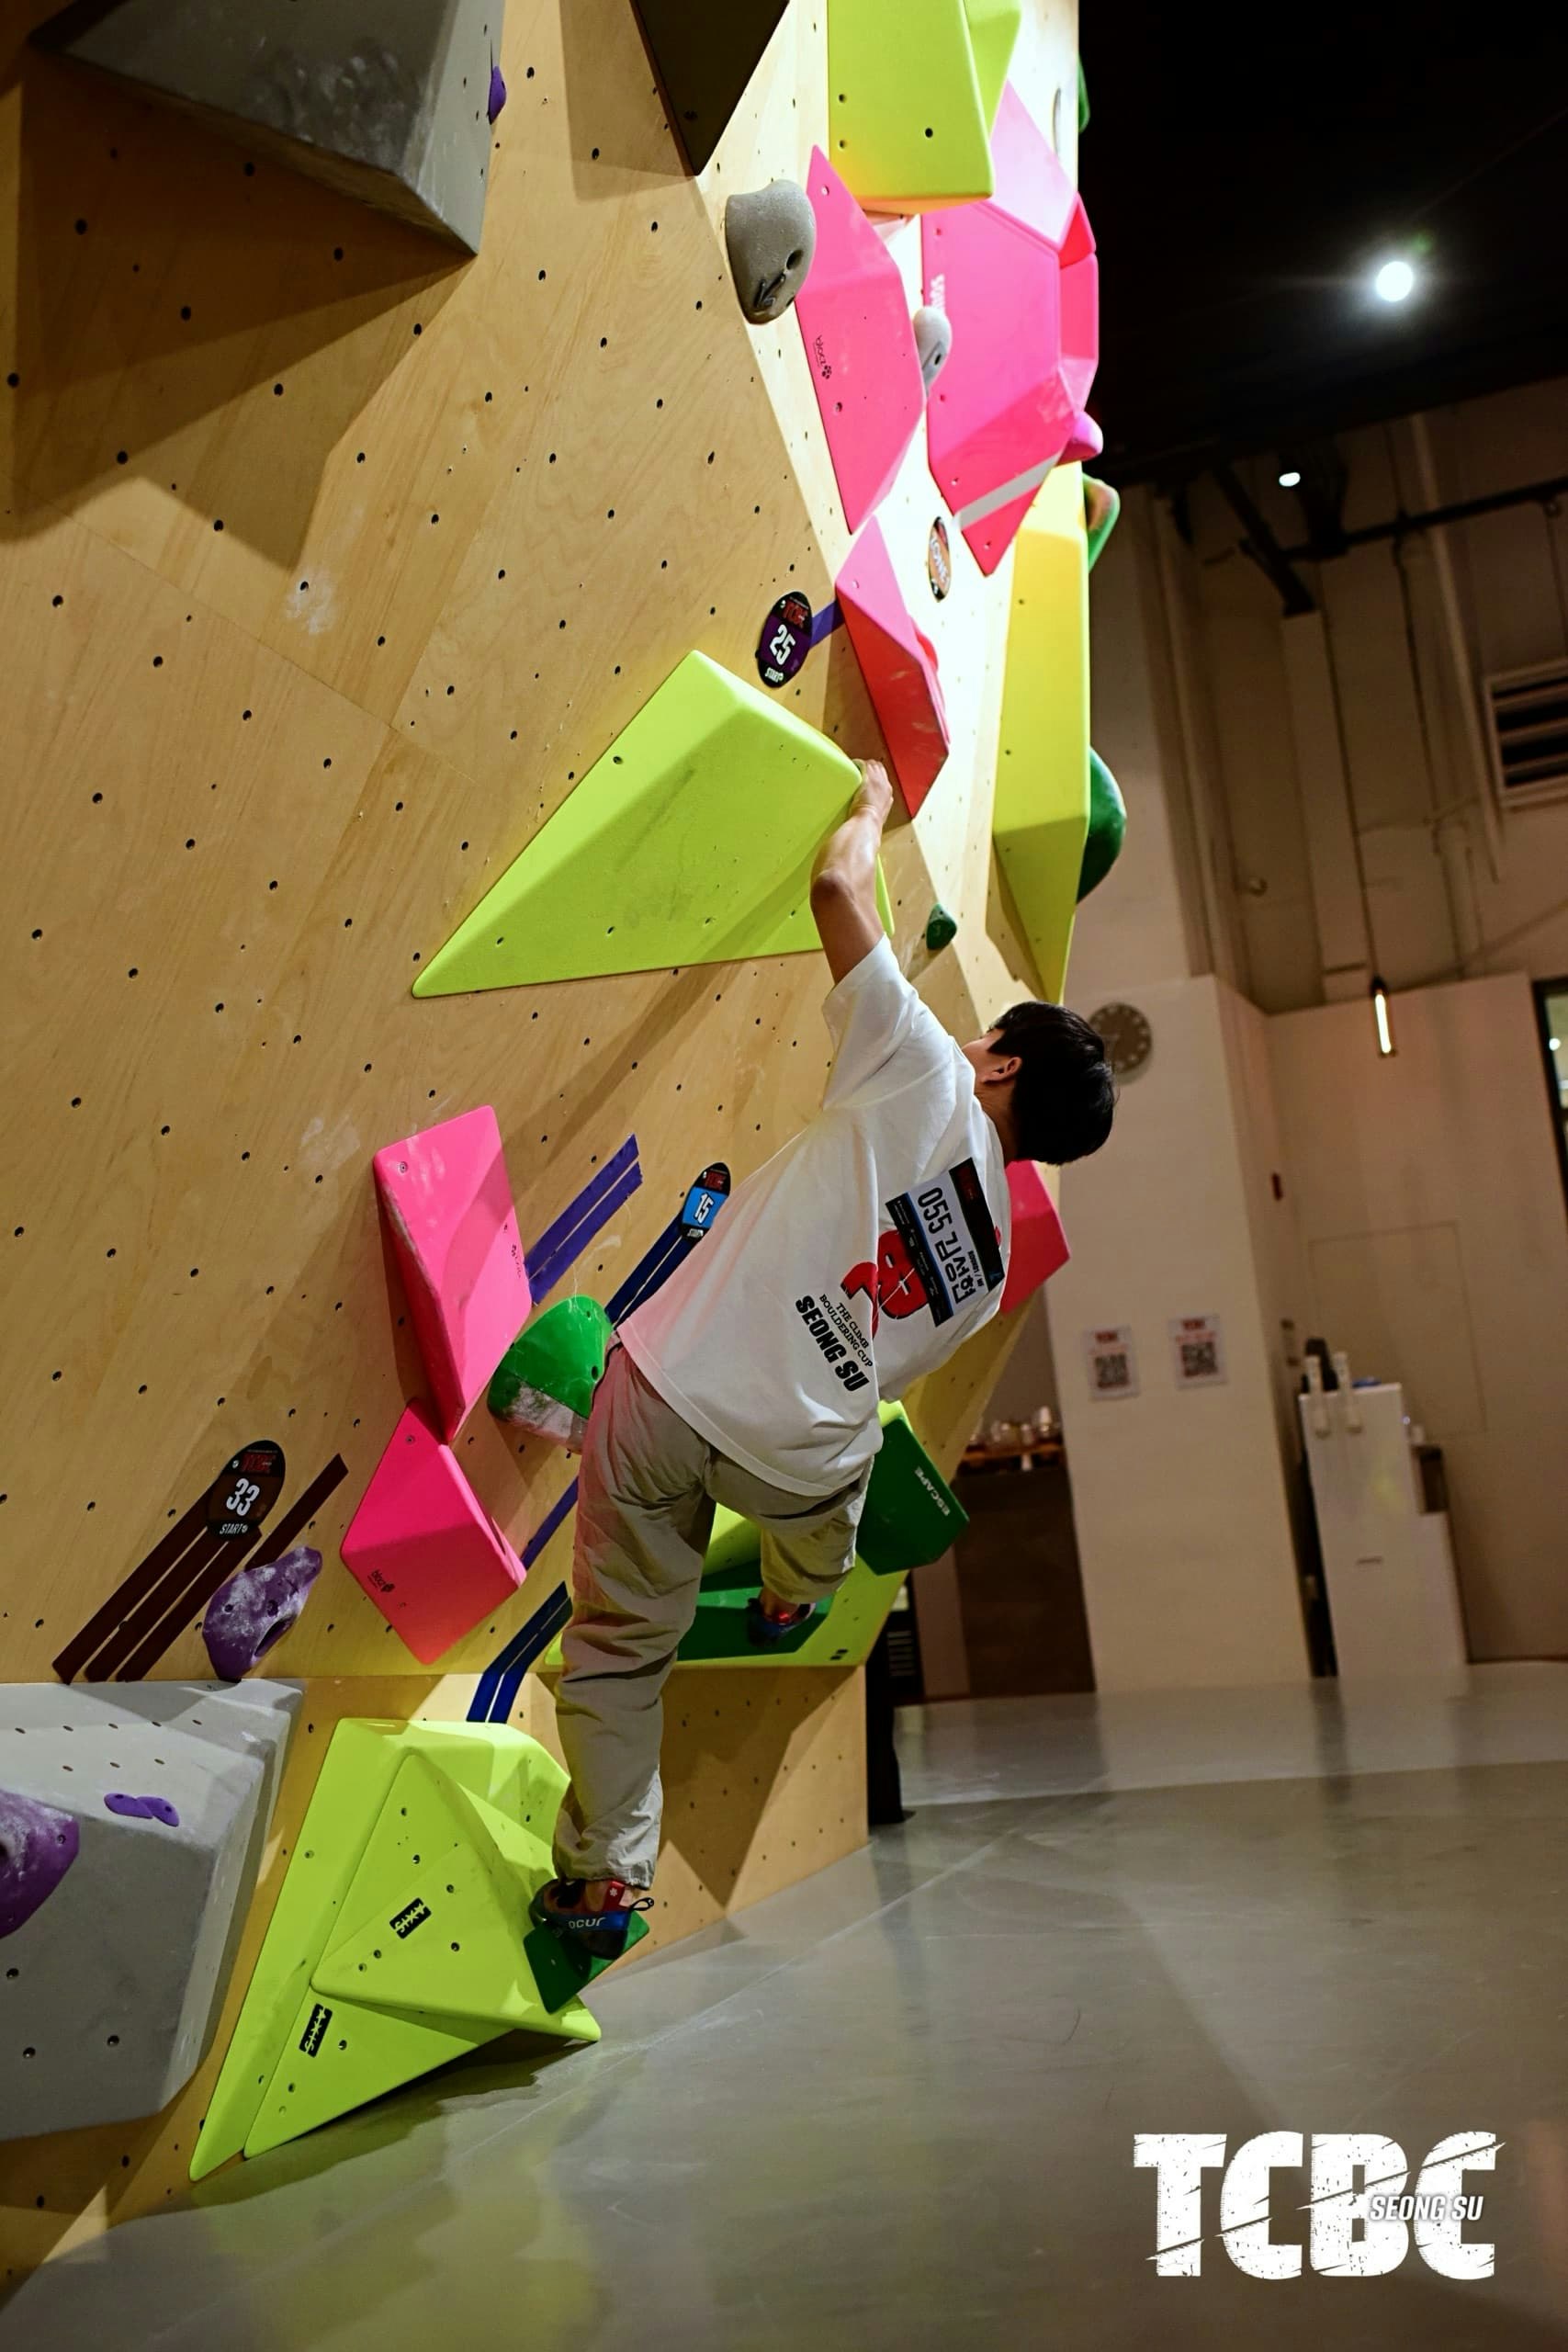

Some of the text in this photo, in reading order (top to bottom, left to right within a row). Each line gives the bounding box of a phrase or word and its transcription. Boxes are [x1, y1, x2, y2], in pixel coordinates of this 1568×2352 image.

[770, 624, 795, 665] 25
[694, 1193, 714, 1224] 15
[918, 1187, 953, 1234] 055
[934, 1230, 976, 1304] 김성현
[795, 1295, 847, 1363] SEONG
[835, 1361, 870, 1392] SU
[819, 1294, 859, 1351] BOULDERING
[857, 1349, 873, 1367] CUP
[836, 1302, 852, 1323] THE
[849, 1320, 869, 1349] CLIMB
[226, 1478, 260, 1516] 33
[915, 1466, 951, 1516] ESCAPE
[220, 1523, 243, 1535] START
